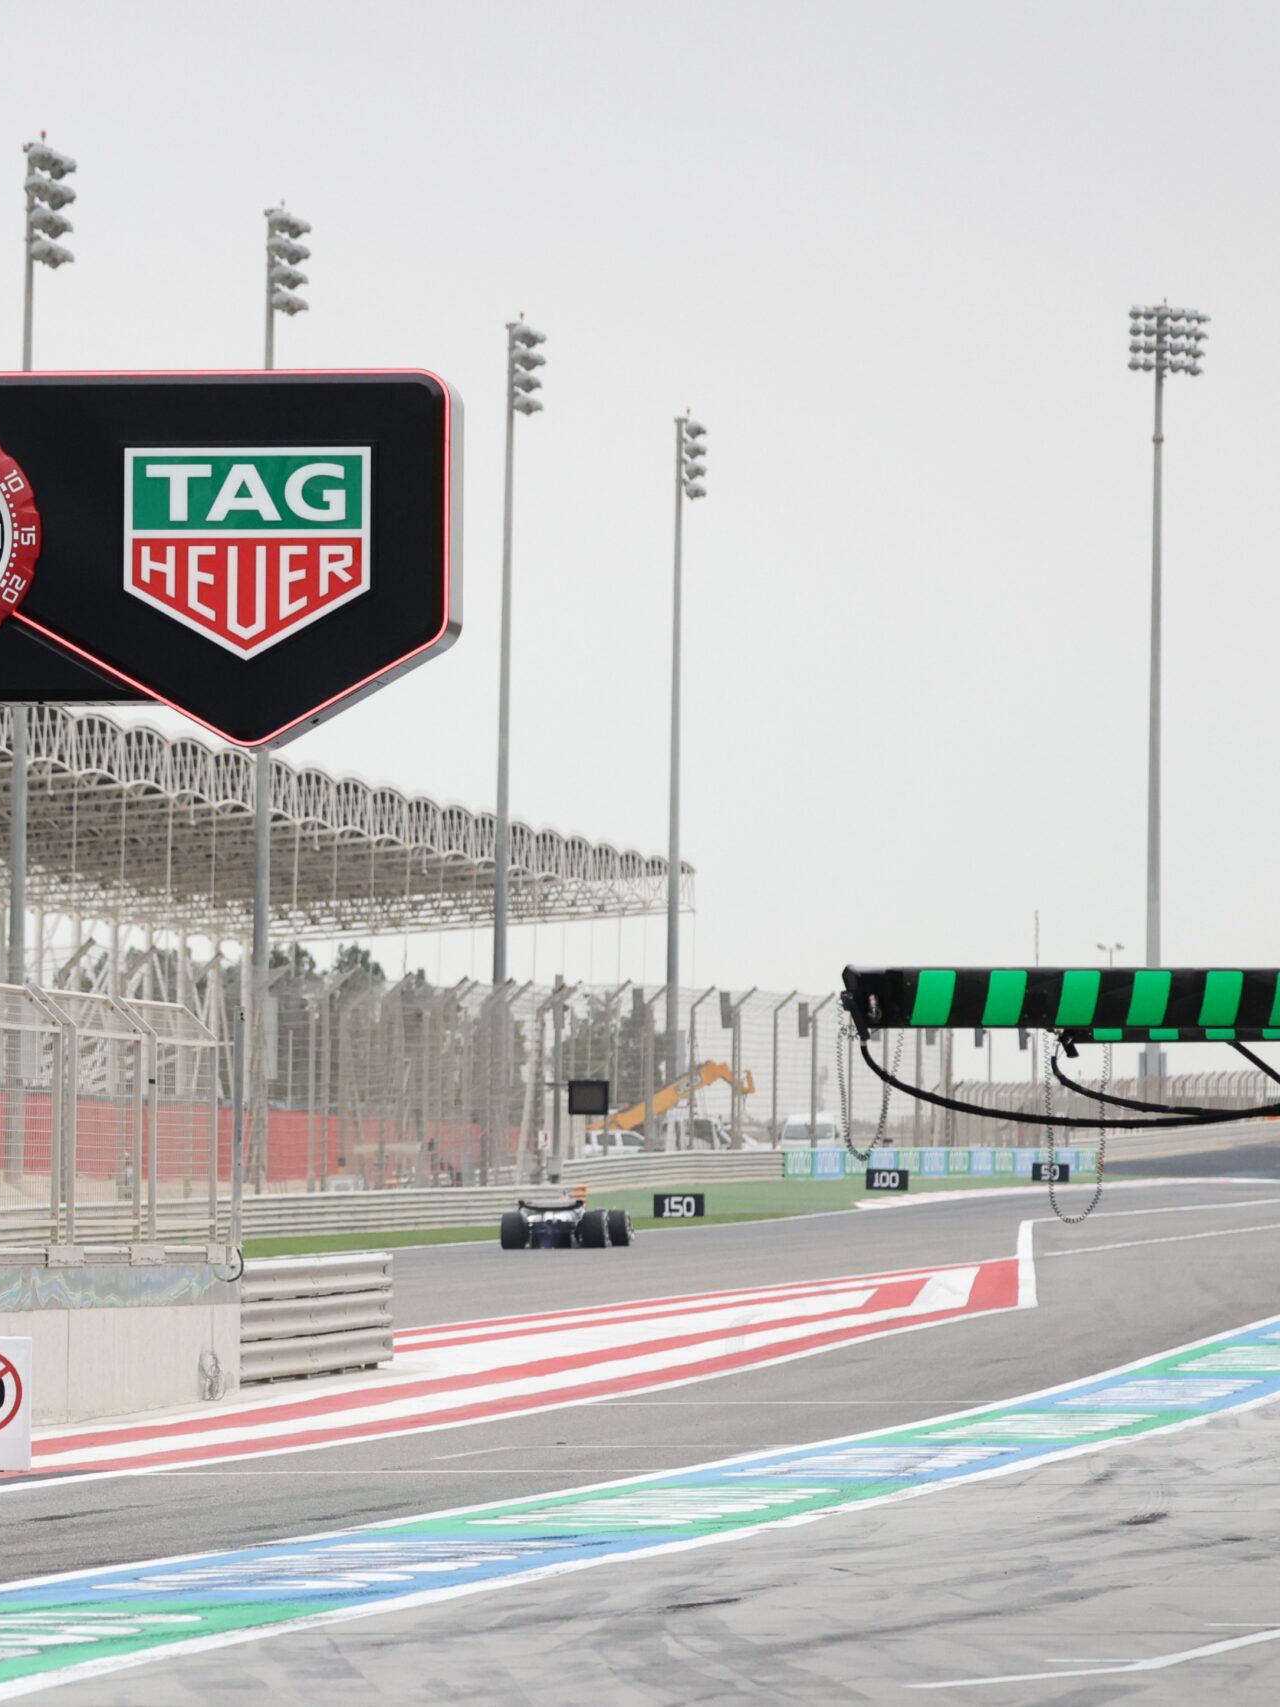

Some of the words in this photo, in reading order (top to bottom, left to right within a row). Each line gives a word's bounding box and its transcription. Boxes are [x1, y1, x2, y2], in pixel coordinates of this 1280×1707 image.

[5, 469, 25, 493] 10
[145, 462, 347, 522] TAG
[21, 524, 36, 546] 15
[1, 576, 27, 604] 20
[140, 544, 354, 641] HEUER
[873, 1172, 900, 1189] 100
[1040, 1164, 1060, 1181] 50
[662, 1196, 696, 1218] 150
